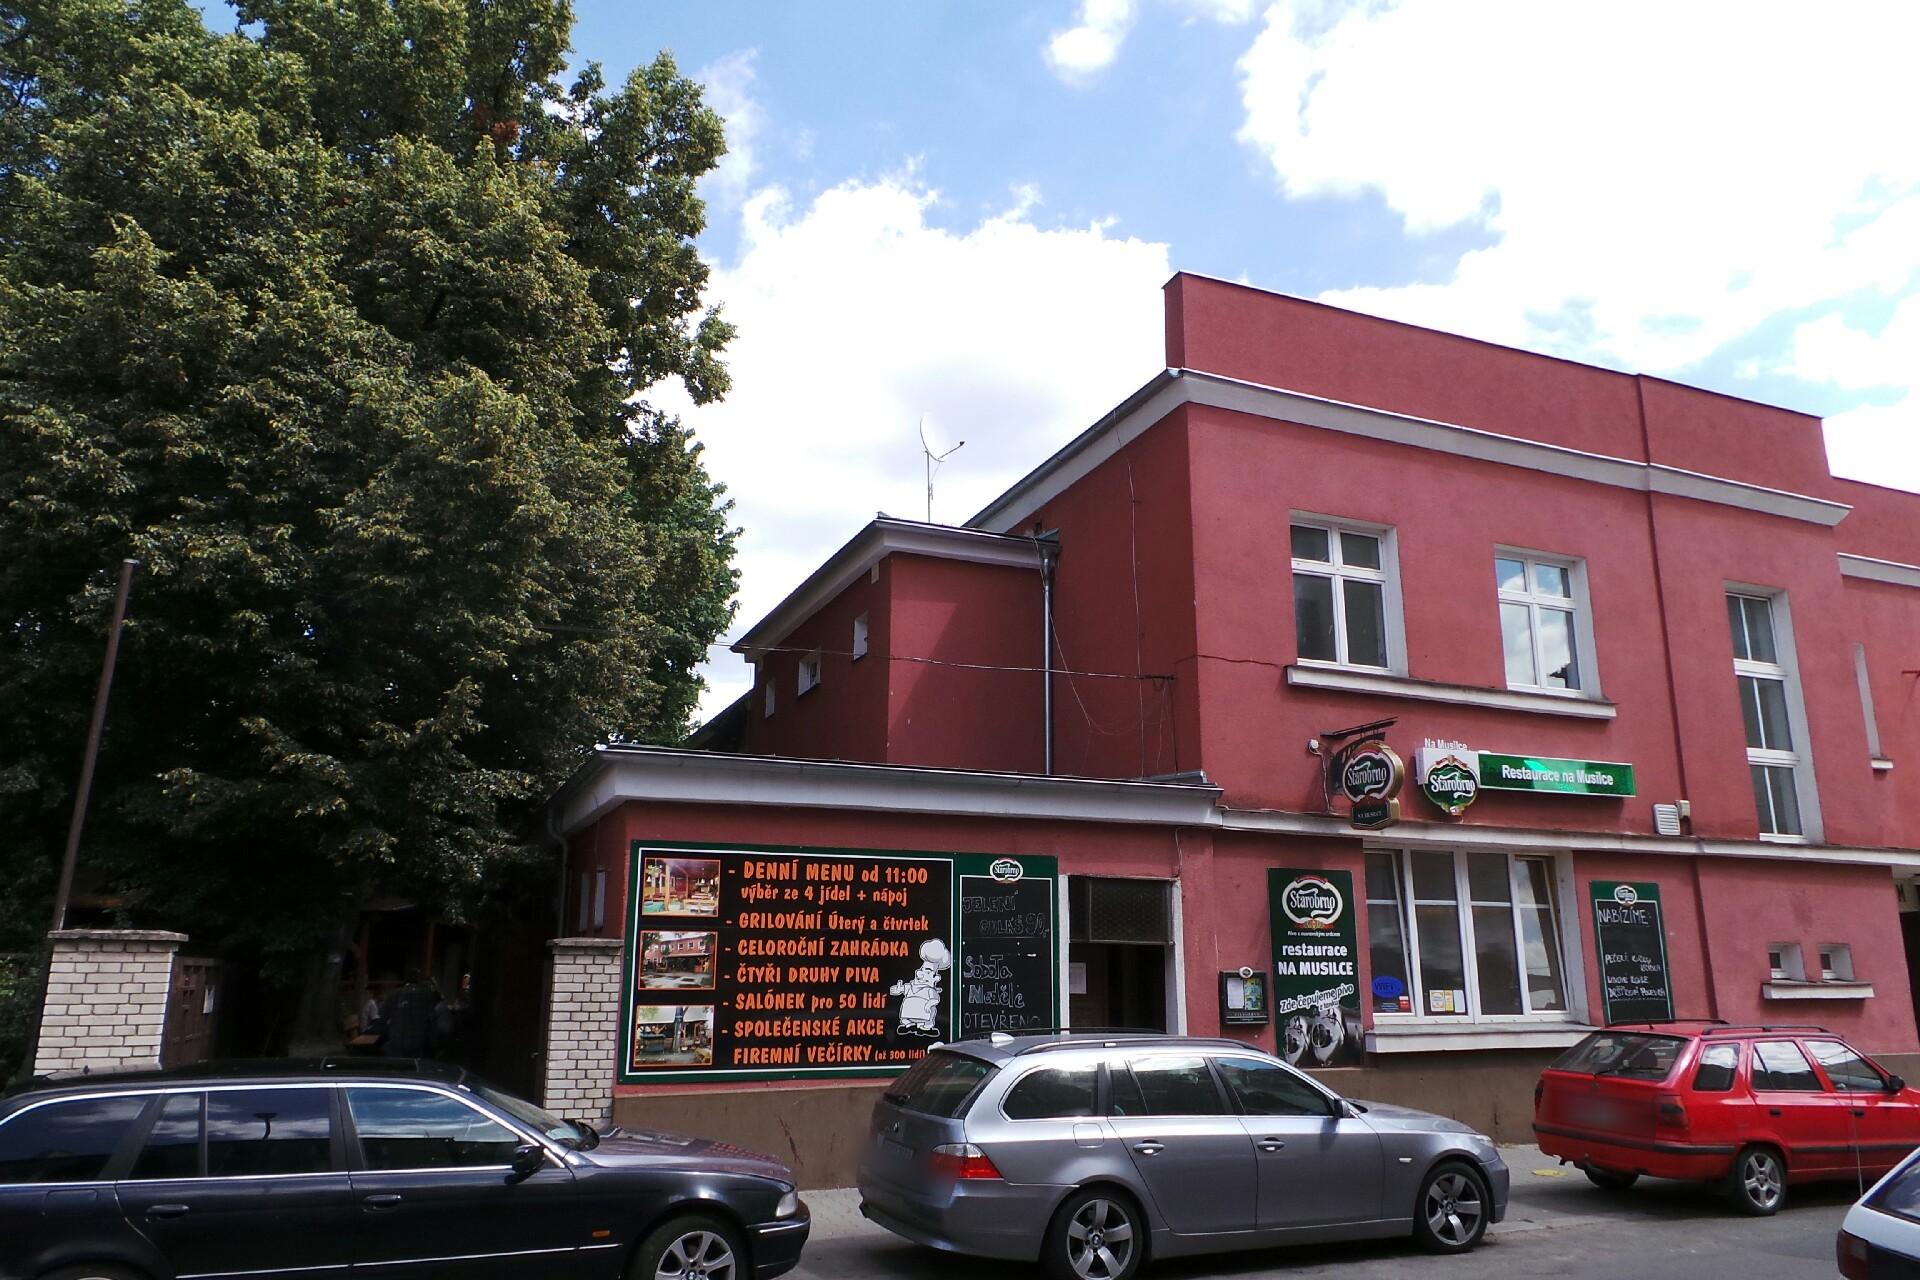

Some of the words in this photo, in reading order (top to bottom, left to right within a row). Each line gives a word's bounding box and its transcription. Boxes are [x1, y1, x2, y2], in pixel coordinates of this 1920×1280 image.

[1348, 761, 1386, 792] Starobrno
[1431, 772, 1476, 798] Starobrno
[1502, 764, 1560, 782] Restaurace
[1562, 772, 1574, 782] na
[1576, 770, 1614, 785] Musilce
[744, 859, 799, 880] DENNÍ
[806, 863, 854, 881] MENU
[861, 865, 878, 882] od
[885, 867, 928, 884] 11:00
[741, 884, 778, 904] výběr
[784, 888, 799, 900] ze
[804, 886, 814, 900] 4
[819, 885, 850, 905] jídel
[872, 888, 908, 906] nápoj
[1290, 888, 1336, 918] Starobrno
[738, 910, 823, 930] GRILOVÁNÍ
[828, 911, 864, 934] Úterý
[870, 919, 877, 930] a
[883, 915, 928, 931] čtvrtek
[738, 937, 825, 956] CELOROČNÍ
[830, 938, 909, 956] ZAHRÁDKA
[1282, 943, 1348, 956] restaurace
[736, 962, 780, 983] ČTYŘI
[788, 966, 840, 983] DRUHY
[846, 967, 879, 983] PIVA
[1278, 962, 1296, 975] NA
[1300, 962, 1354, 976] MUSILCE
[735, 990, 805, 1010] SALÓNEK
[811, 994, 832, 1012] pro
[839, 994, 857, 1008] 50
[862, 992, 887, 1008] lidí
[1280, 1000, 1296, 1012] Zde
[1298, 989, 1336, 1008] čepujeme
[1336, 984, 1354, 998] pivo
[734, 1016, 840, 1038] SPOLEČENSKÉ
[846, 1019, 884, 1036] AKCE
[734, 1043, 801, 1064] FIREMNÍ
[807, 1042, 872, 1063] VEČÍRKY
[889, 1050, 905, 1060] 300
